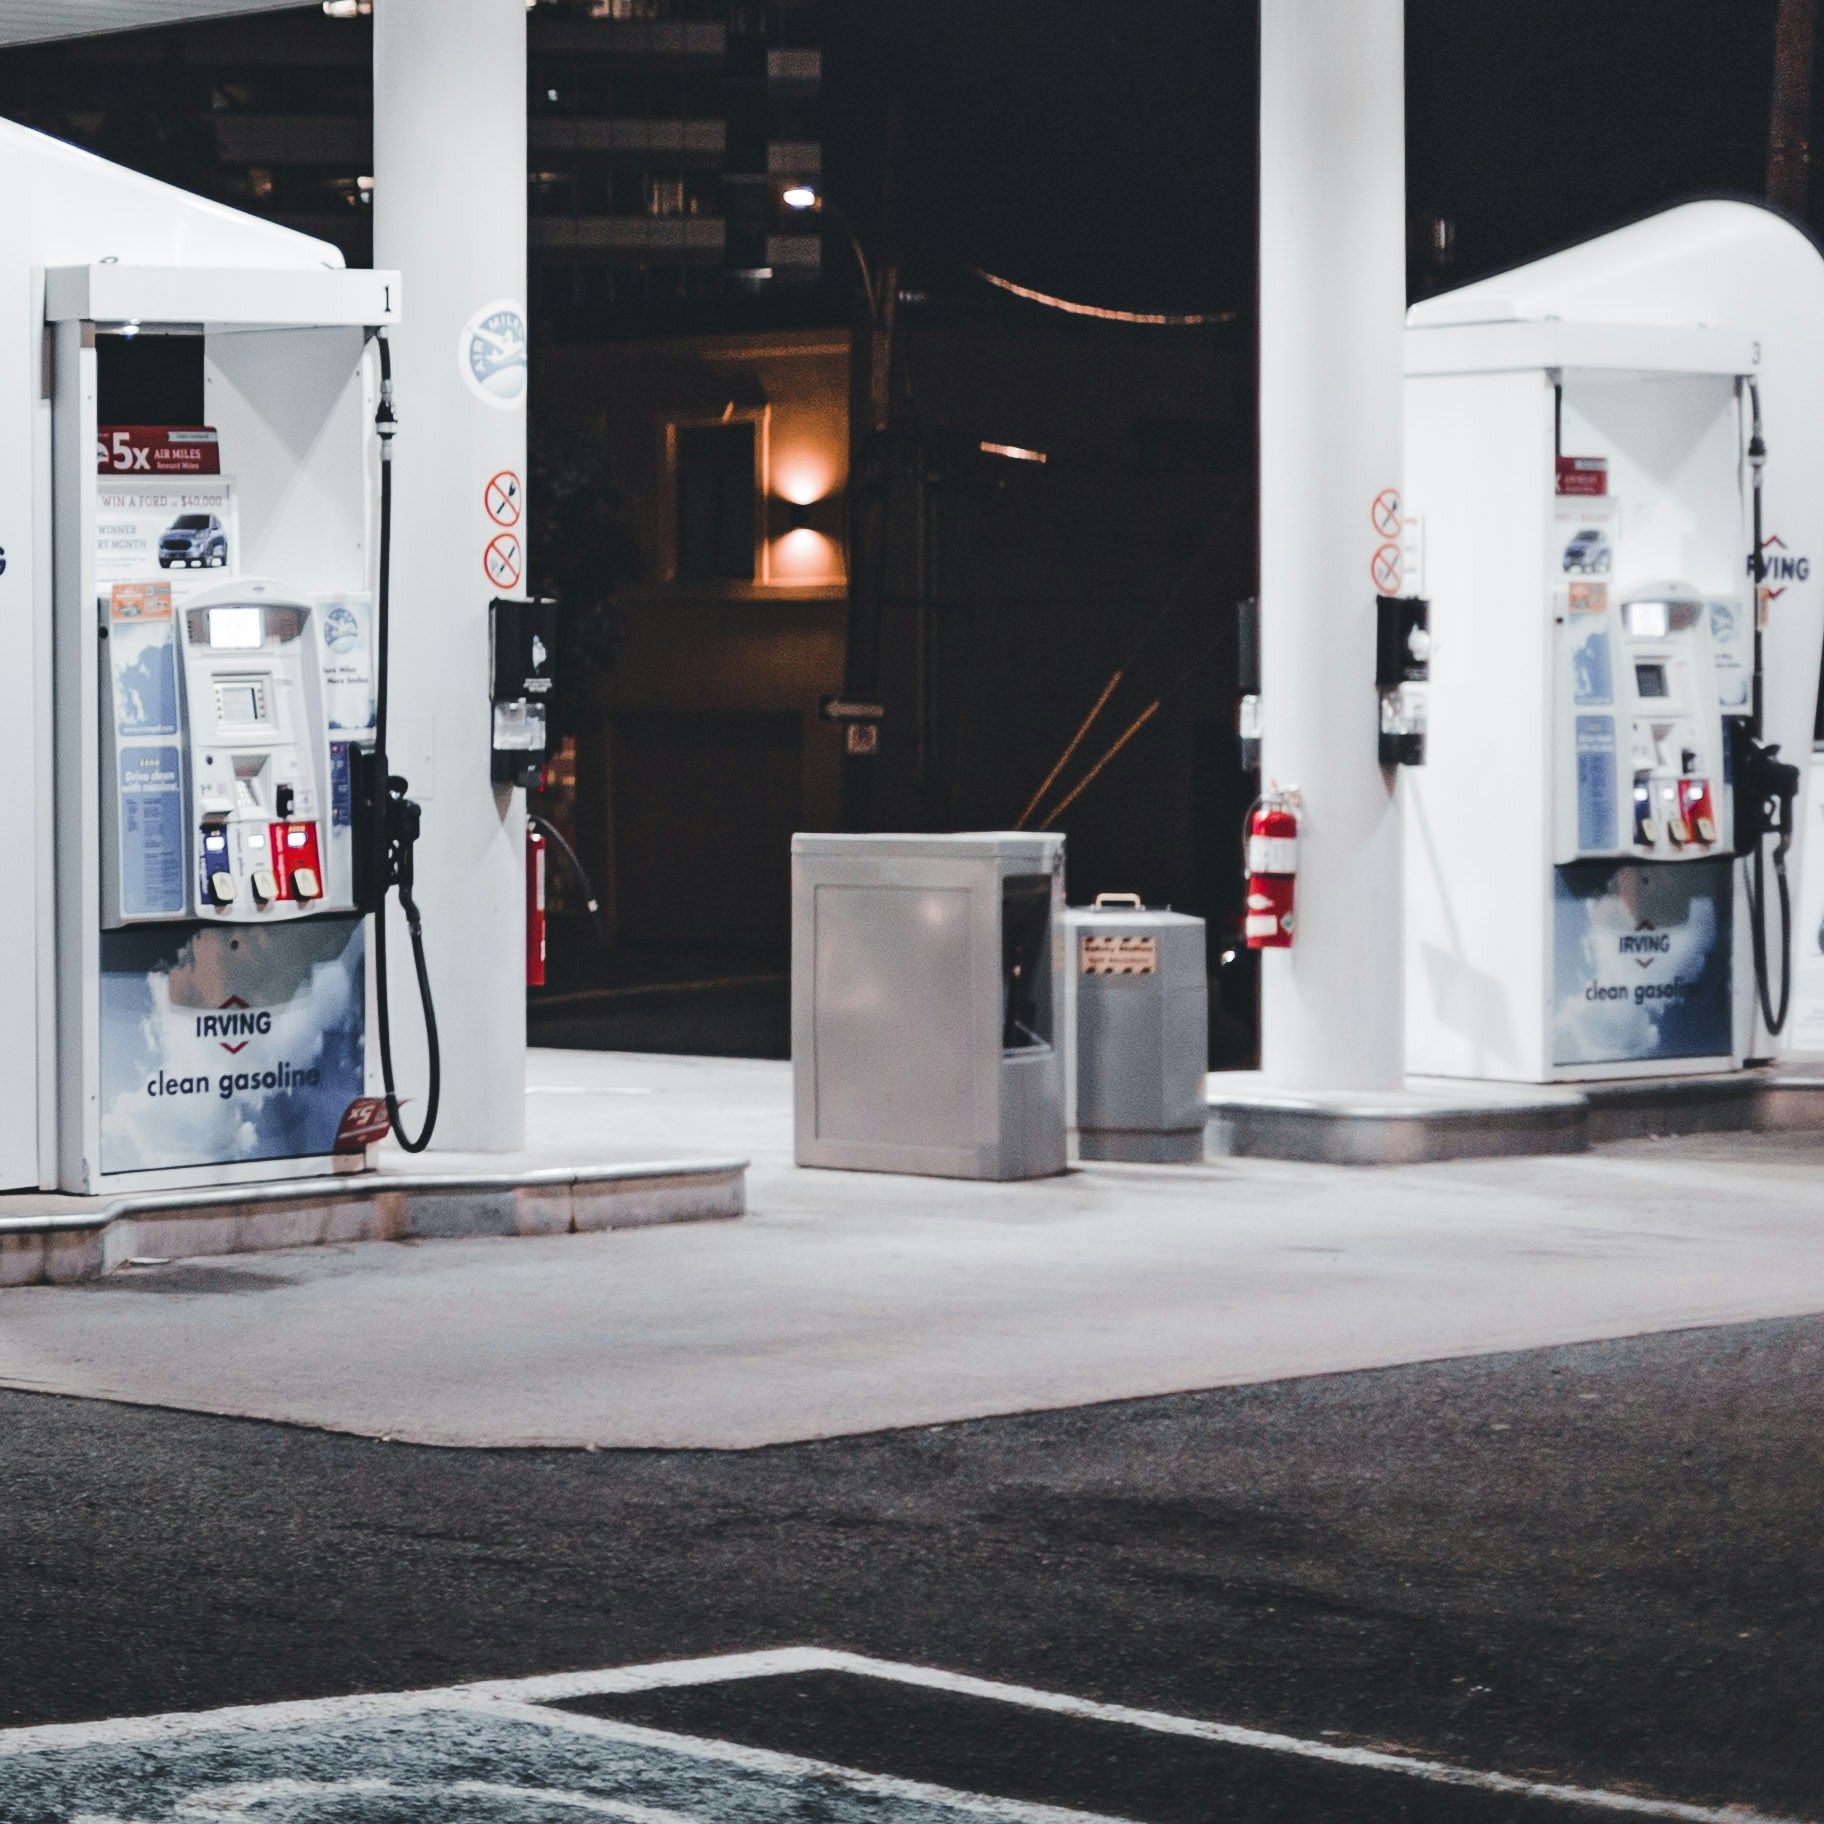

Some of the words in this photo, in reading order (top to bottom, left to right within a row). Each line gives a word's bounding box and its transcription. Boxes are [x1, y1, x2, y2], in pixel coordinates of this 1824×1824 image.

[384, 285, 391, 312] 1
[1752, 341, 1761, 365] 3
[112, 431, 151, 469] 5x
[153, 449, 170, 459] AIR
[172, 448, 201, 459] MILES
[101, 495, 125, 507] WIN
[128, 495, 137, 507] A
[139, 495, 168, 507] FORD
[97, 524, 137, 534] WINNER
[111, 539, 147, 549] MONTH
[1619, 935, 1670, 953] IRVING
[1586, 979, 1628, 1001] clean
[196, 1011, 271, 1037] IRVING
[147, 1070, 209, 1096] clean
[219, 1061, 322, 1099] gasoline
